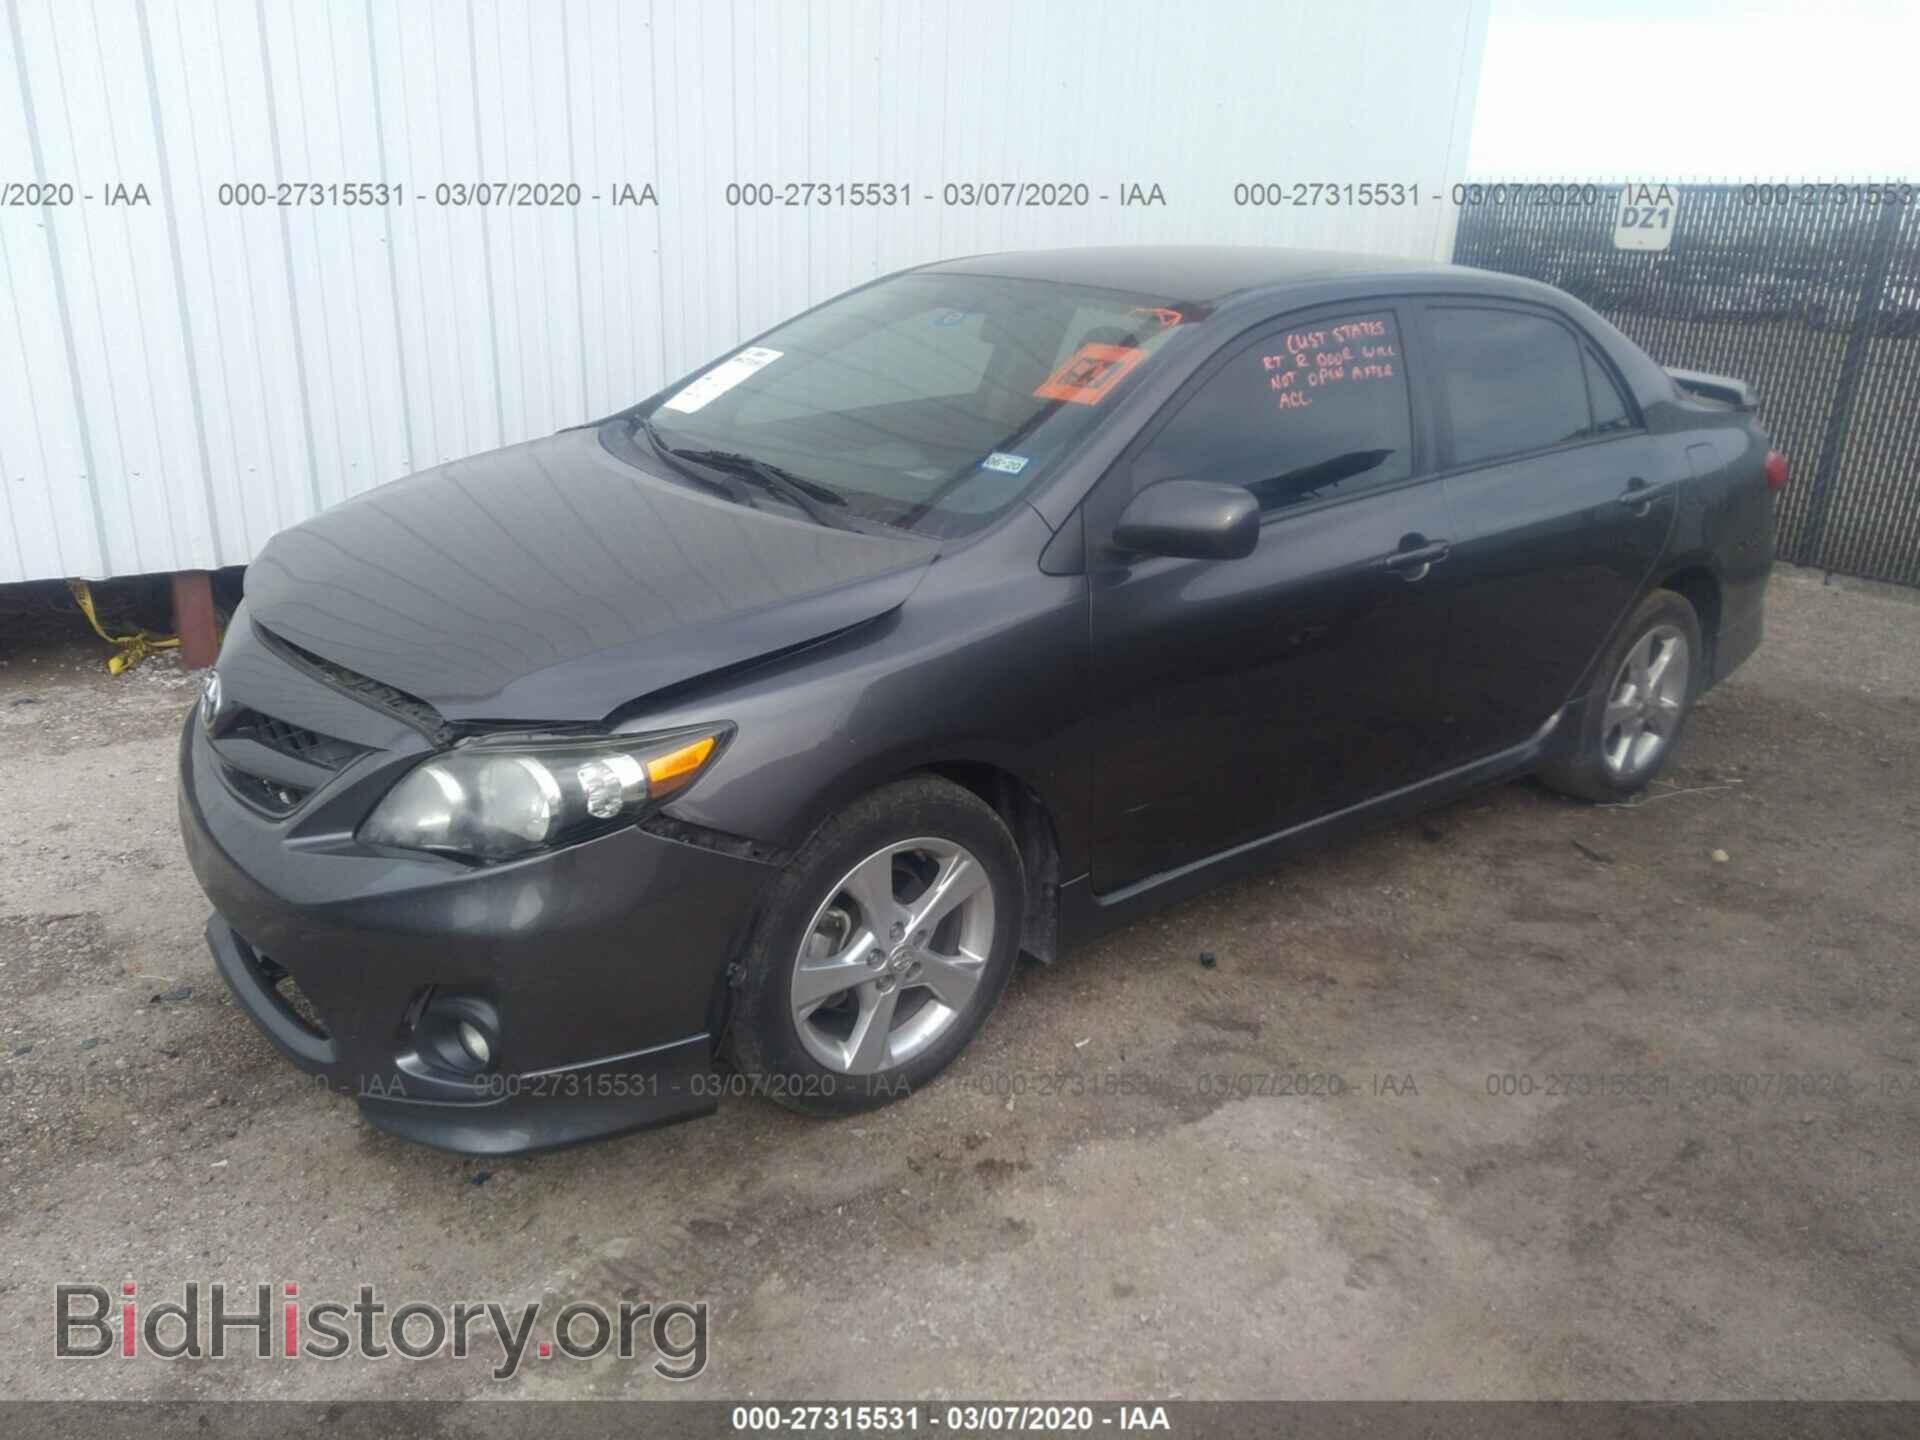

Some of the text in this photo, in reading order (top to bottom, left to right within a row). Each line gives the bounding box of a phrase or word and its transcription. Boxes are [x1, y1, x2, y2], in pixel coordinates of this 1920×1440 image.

[1621, 207, 1669, 229] DZ1
[1270, 371, 1296, 391] NOT
[1308, 366, 1344, 386] OPEN
